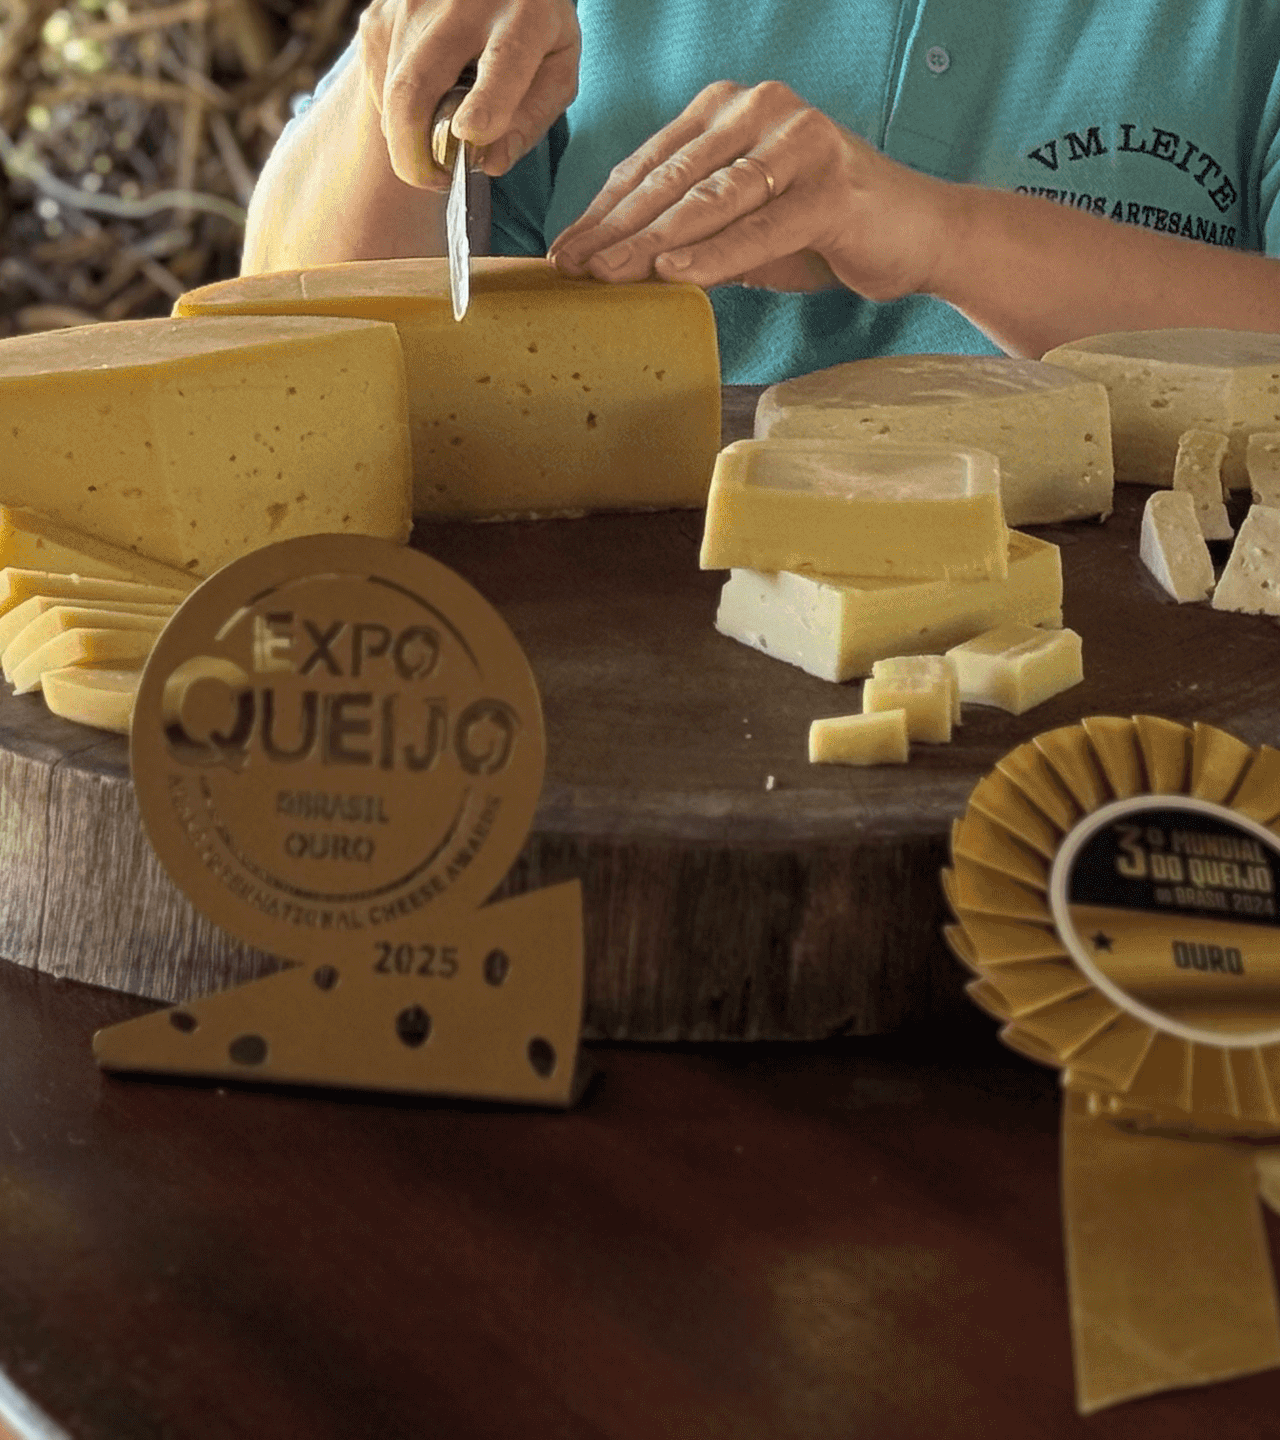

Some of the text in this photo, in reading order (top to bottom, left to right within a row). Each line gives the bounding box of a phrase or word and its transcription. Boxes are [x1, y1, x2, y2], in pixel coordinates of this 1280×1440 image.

[1117, 123, 1238, 214] LEITE
[1110, 200, 1237, 247] ARTESANAIS
[253, 611, 441, 682] EXPO
[161, 655, 521, 776] QUEIJO
[284, 831, 377, 863] OURO
[368, 873, 447, 927] CHEESE
[445, 793, 502, 883] AWARDS
[1170, 830, 1267, 864] MUNDIAL
[1150, 853, 1274, 894] DO QUEIJO
[1173, 886, 1228, 910] BRASIL
[372, 940, 459, 978] 2025
[1172, 939, 1245, 976] OURO
